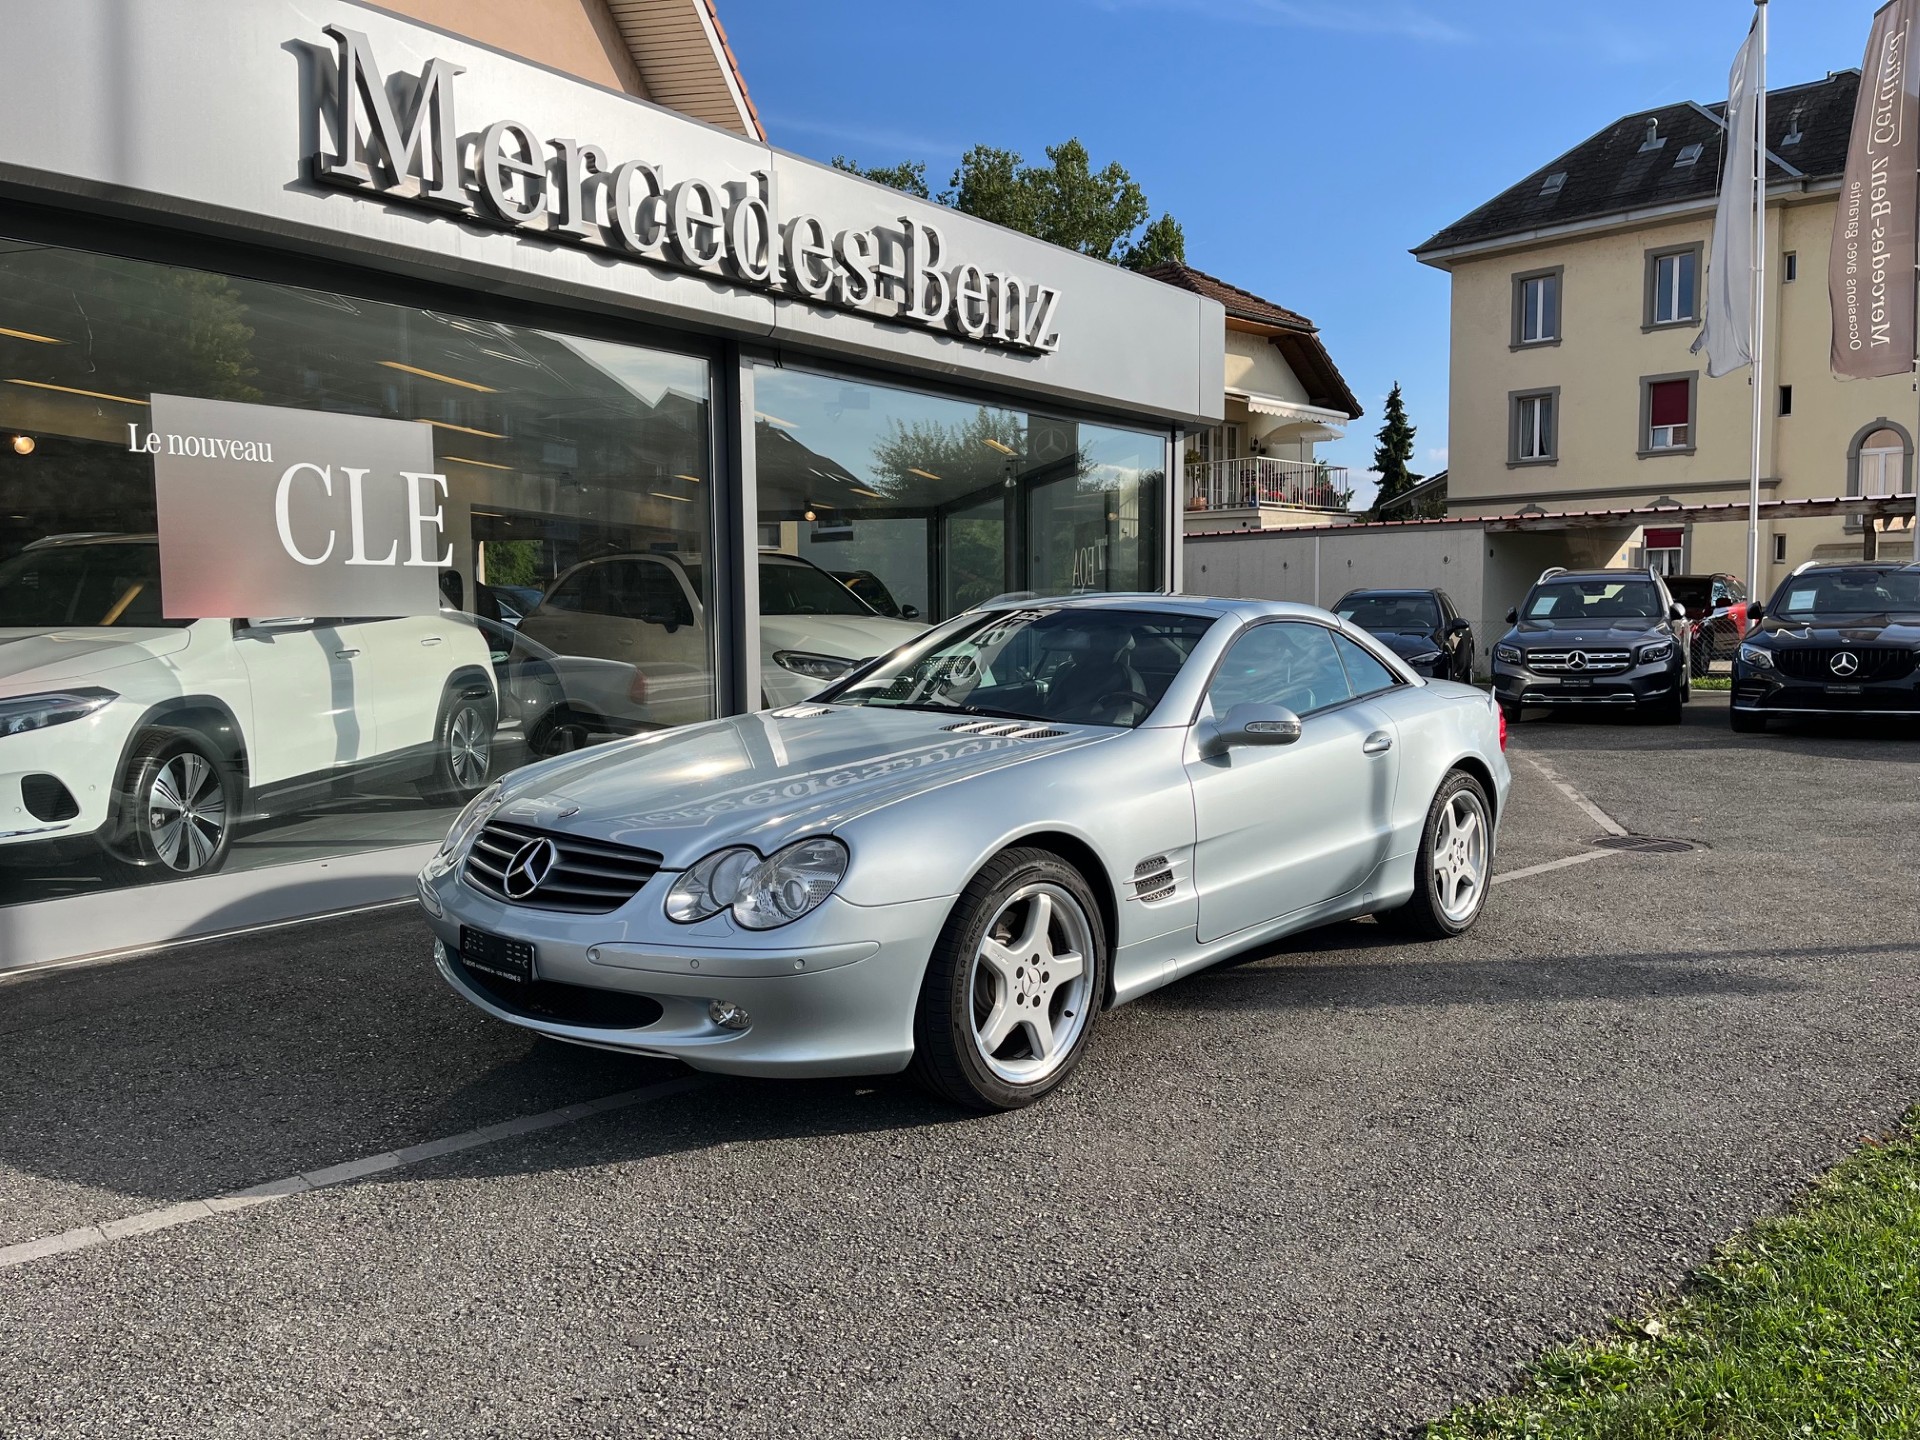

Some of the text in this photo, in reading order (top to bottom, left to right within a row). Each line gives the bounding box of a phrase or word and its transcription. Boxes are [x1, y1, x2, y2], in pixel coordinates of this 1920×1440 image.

[314, 23, 1063, 355] Mercedes-Benz
[127, 423, 274, 463] Le nouveau
[274, 462, 454, 567] CLE
